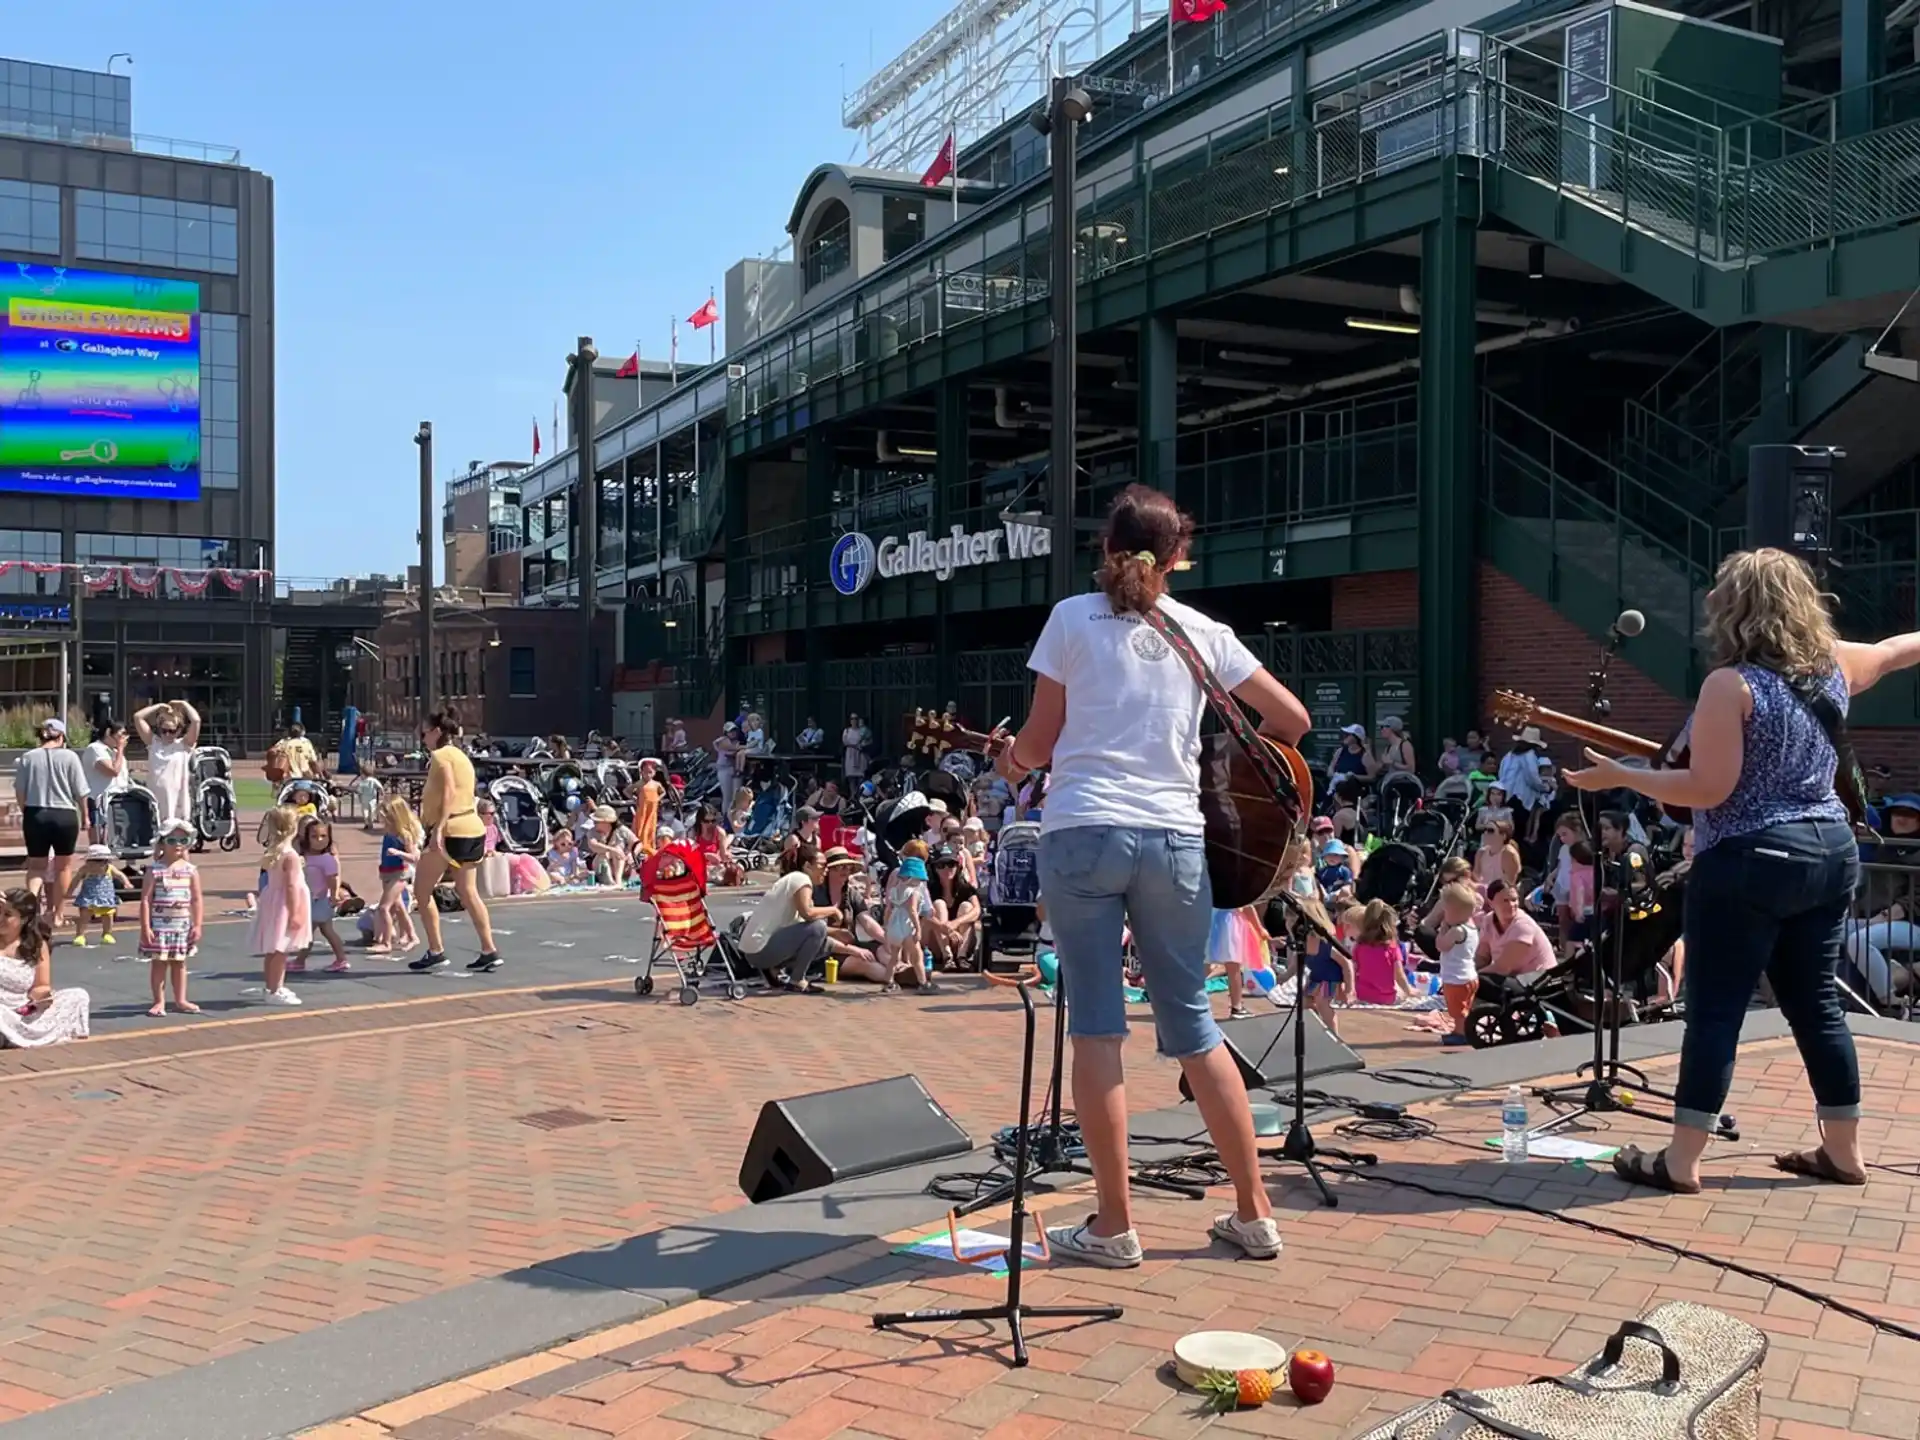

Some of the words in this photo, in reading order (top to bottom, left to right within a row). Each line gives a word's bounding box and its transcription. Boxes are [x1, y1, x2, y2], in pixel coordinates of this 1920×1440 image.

[82, 342, 135, 357] Gallagher
[136, 347, 160, 360] Way
[877, 524, 1004, 581] Gallagher
[1002, 520, 1051, 560] Wa
[1273, 559, 1284, 575] 4
[0, 605, 70, 621] TORE
